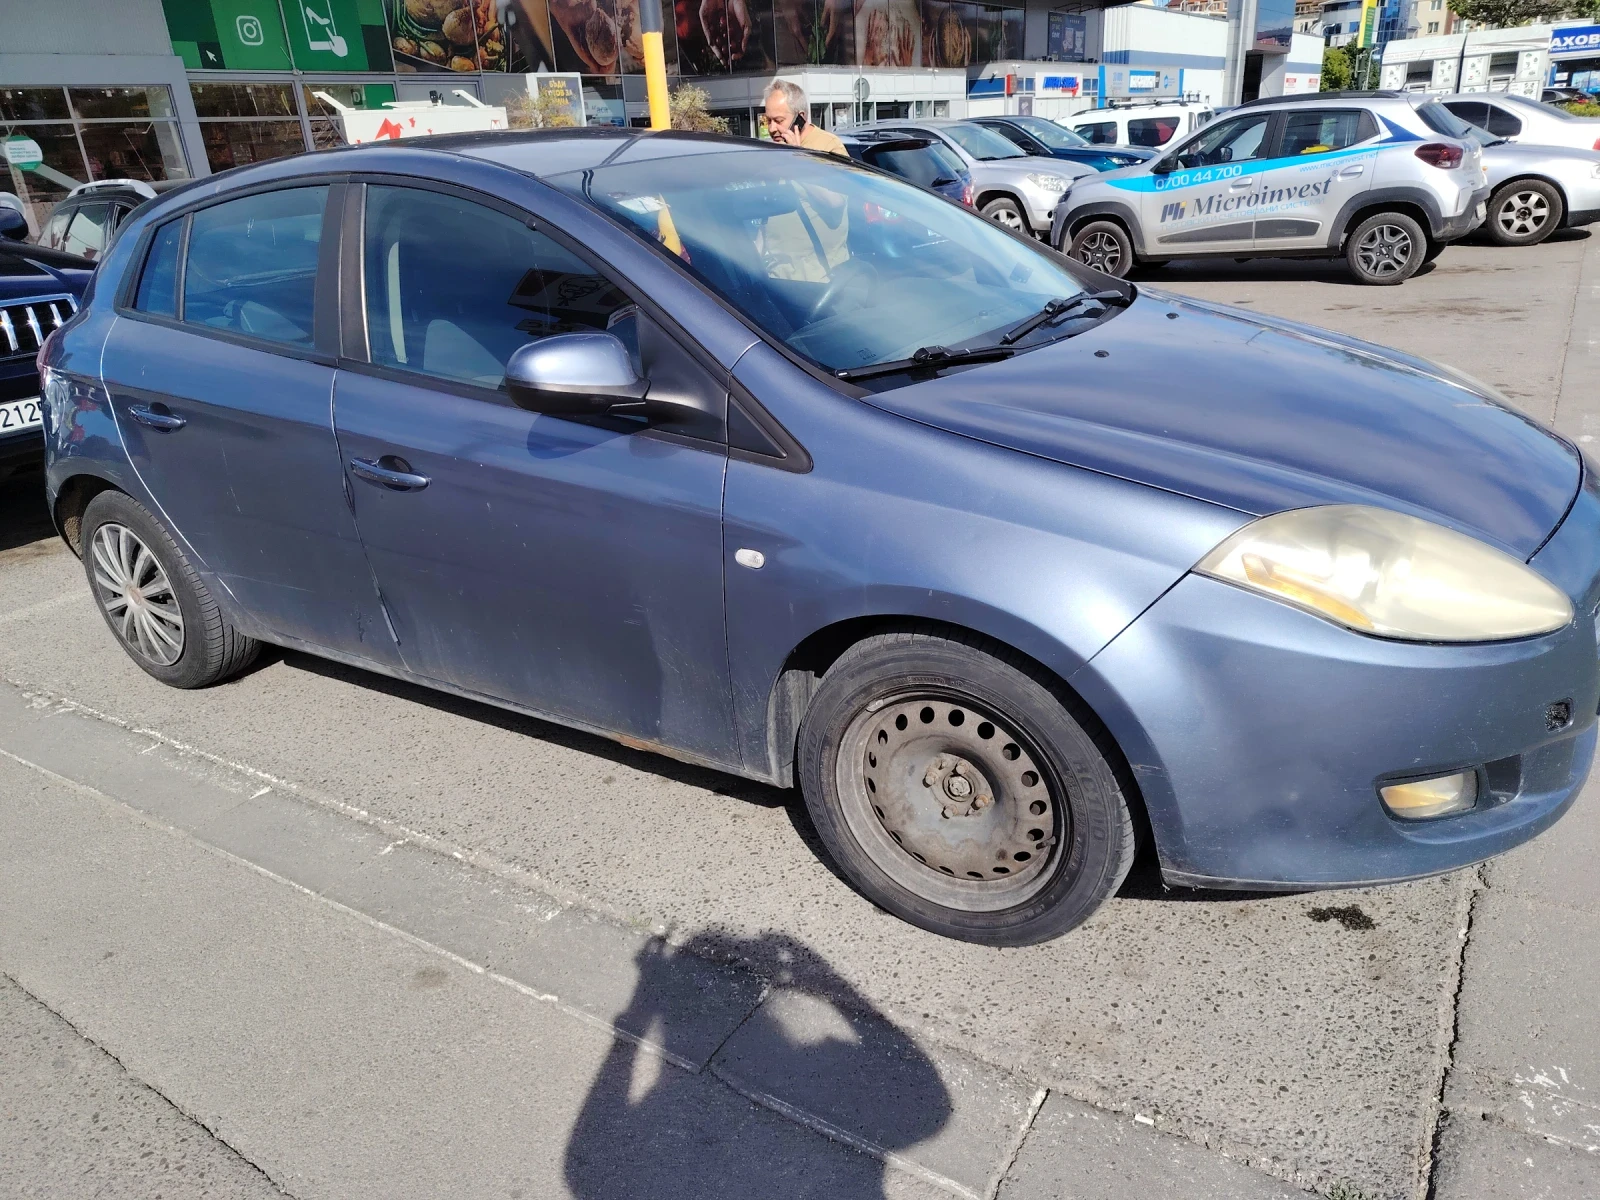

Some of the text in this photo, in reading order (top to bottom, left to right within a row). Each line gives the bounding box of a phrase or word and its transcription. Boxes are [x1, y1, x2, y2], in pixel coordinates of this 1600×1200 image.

[1299, 151, 1379, 173] www.microinvest.net
[1155, 164, 1242, 190] 0700 44 700
[1191, 176, 1332, 217] Microinvest
